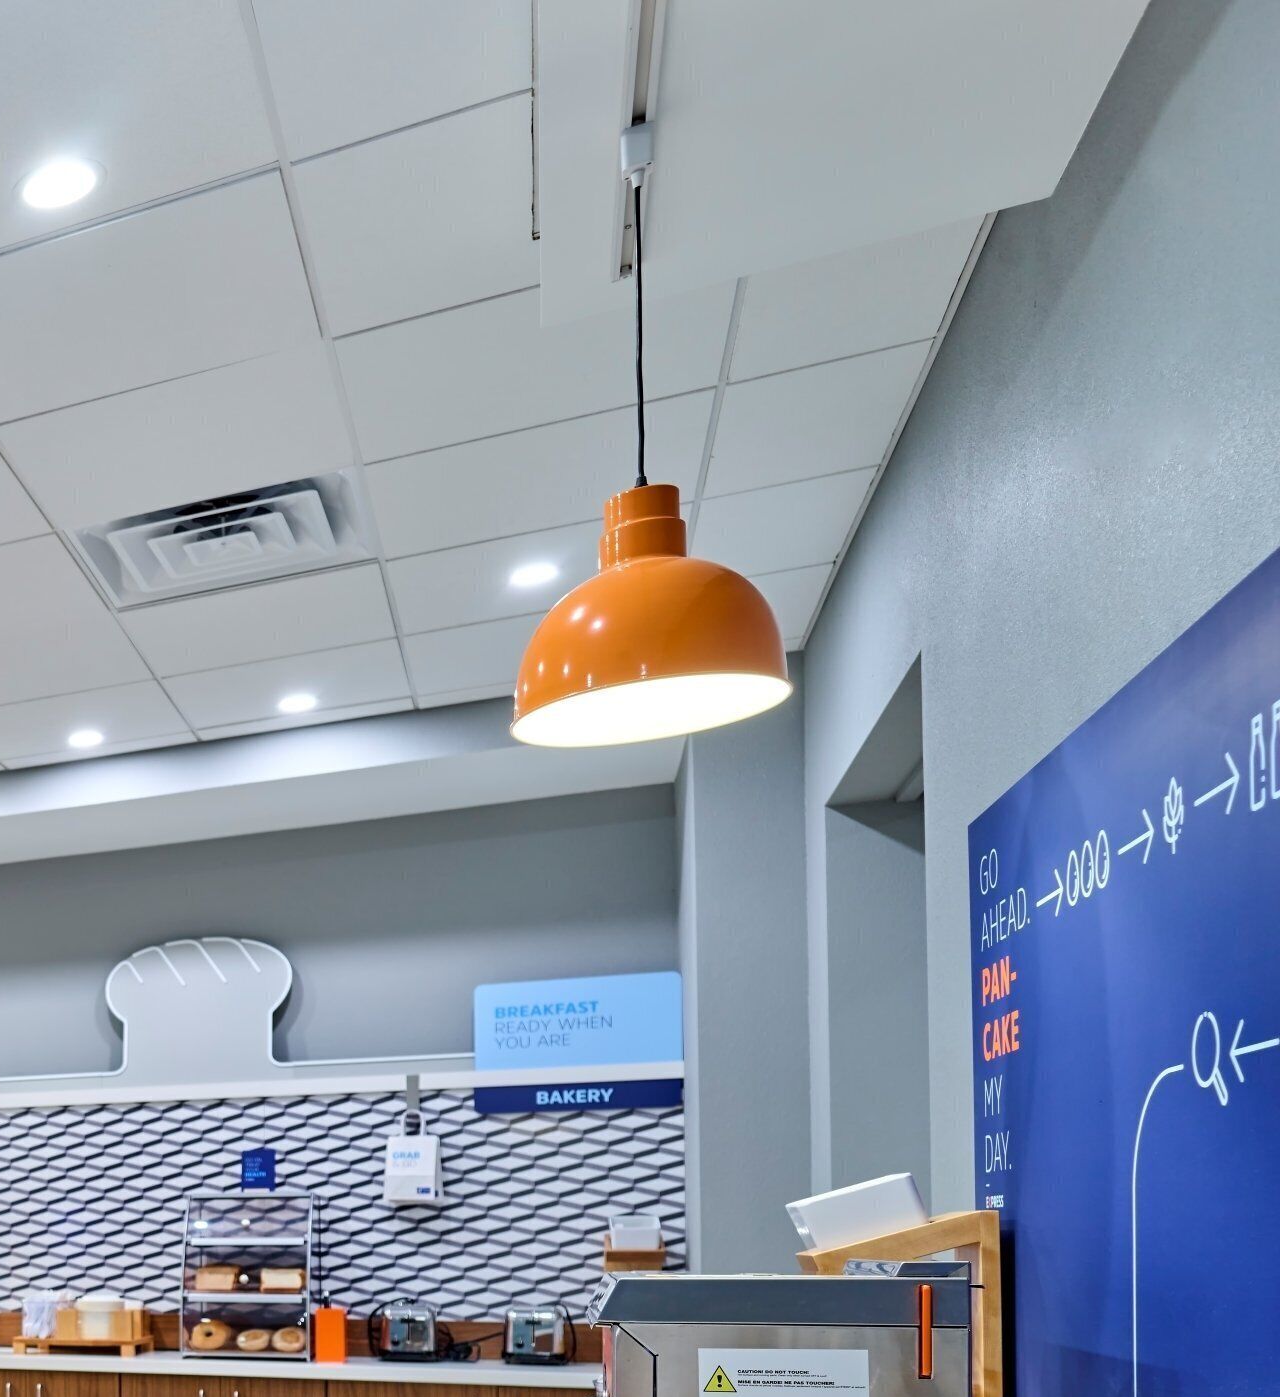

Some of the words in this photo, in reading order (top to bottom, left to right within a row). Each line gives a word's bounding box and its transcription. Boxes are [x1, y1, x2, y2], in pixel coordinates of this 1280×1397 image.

[979, 848, 999, 896] GO
[981, 887, 1031, 953] AHEAD.
[982, 956, 1017, 1007] PAN-
[494, 1000, 599, 1019] BREAKFAST
[494, 1018, 552, 1035] READY
[557, 1015, 614, 1032] WHEN
[494, 1035, 531, 1050] YOU
[537, 1033, 571, 1048] ARE
[982, 1010, 1020, 1062] CAKE
[536, 1087, 614, 1105] BAKERY
[984, 1074, 1003, 1118] MY
[985, 1130, 1012, 1173] DAY.
